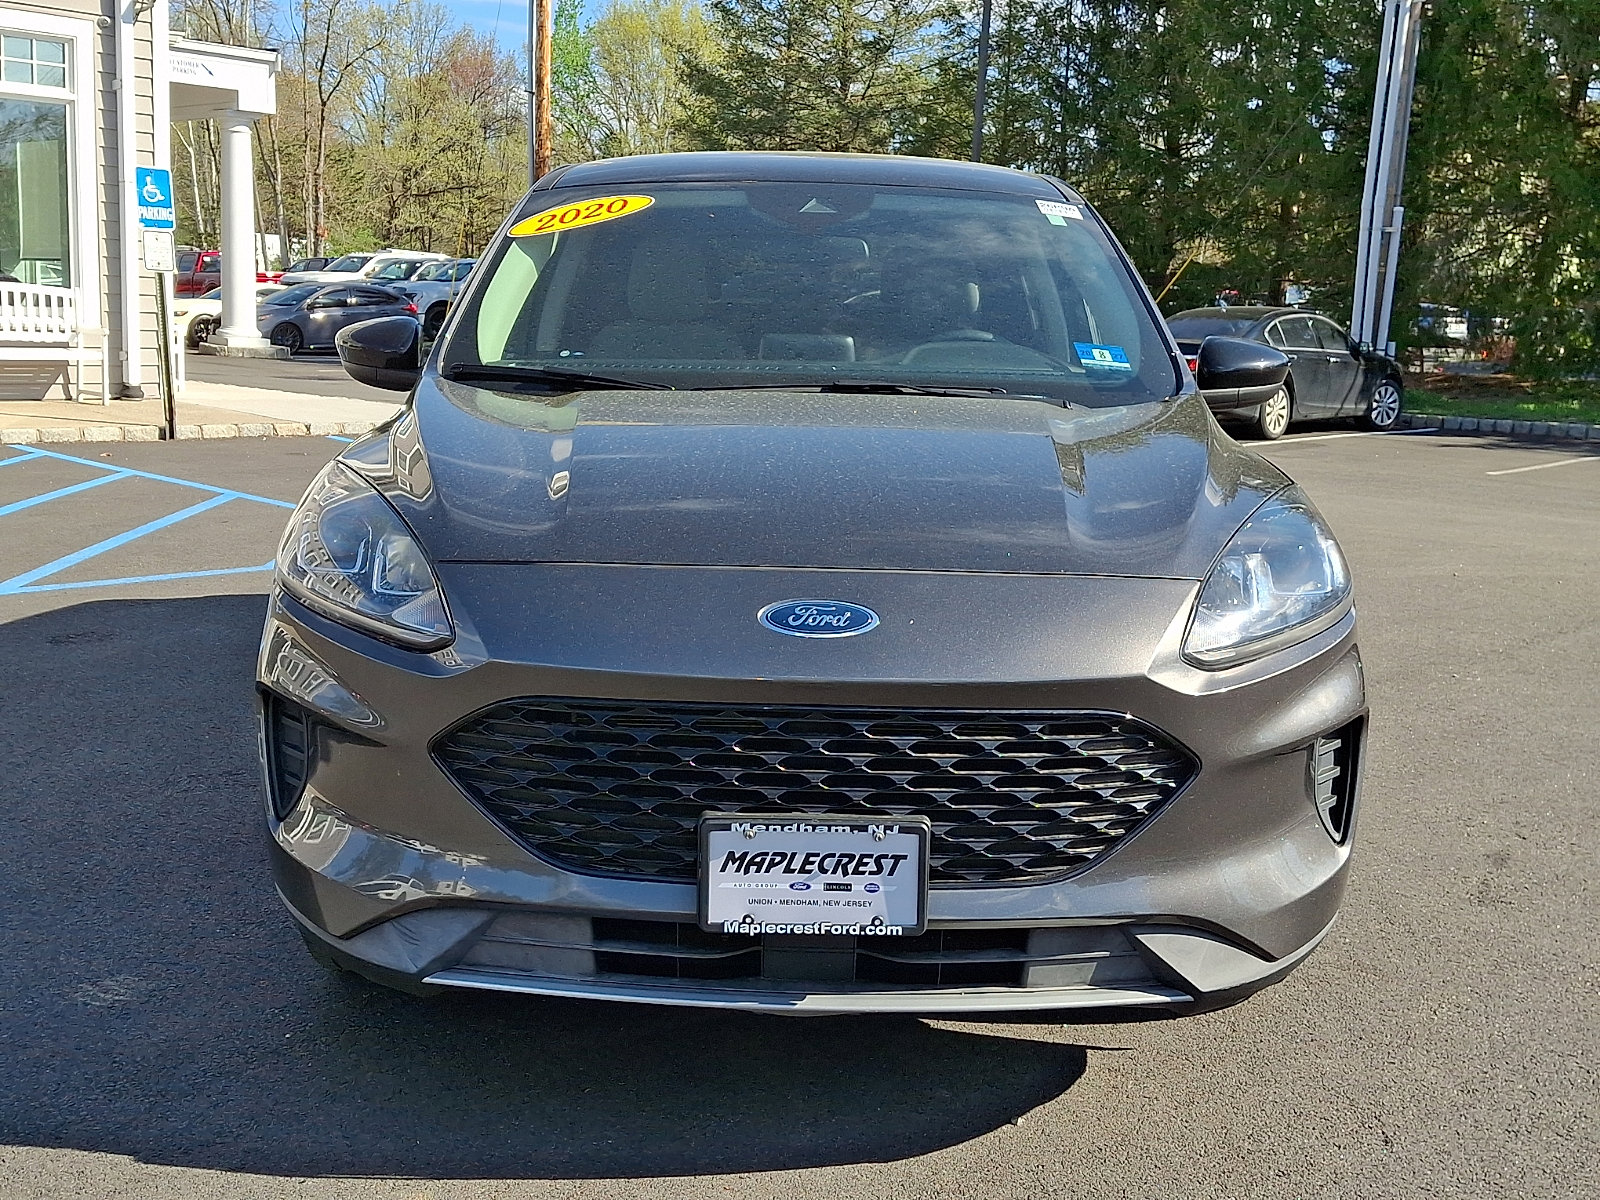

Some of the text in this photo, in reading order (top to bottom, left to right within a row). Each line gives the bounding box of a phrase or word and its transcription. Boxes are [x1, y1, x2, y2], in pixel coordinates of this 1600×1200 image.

[138, 206, 173, 221] PARKING
[534, 199, 628, 232] 2020
[1098, 350, 1107, 359] 8
[787, 605, 852, 627] Ford
[867, 824, 899, 835] NJ
[719, 850, 908, 878] MAPLECREST
[748, 898, 873, 908] UNION MENDHAM, NEW JERSEY
[723, 919, 903, 936] MaplecrestFord.com
